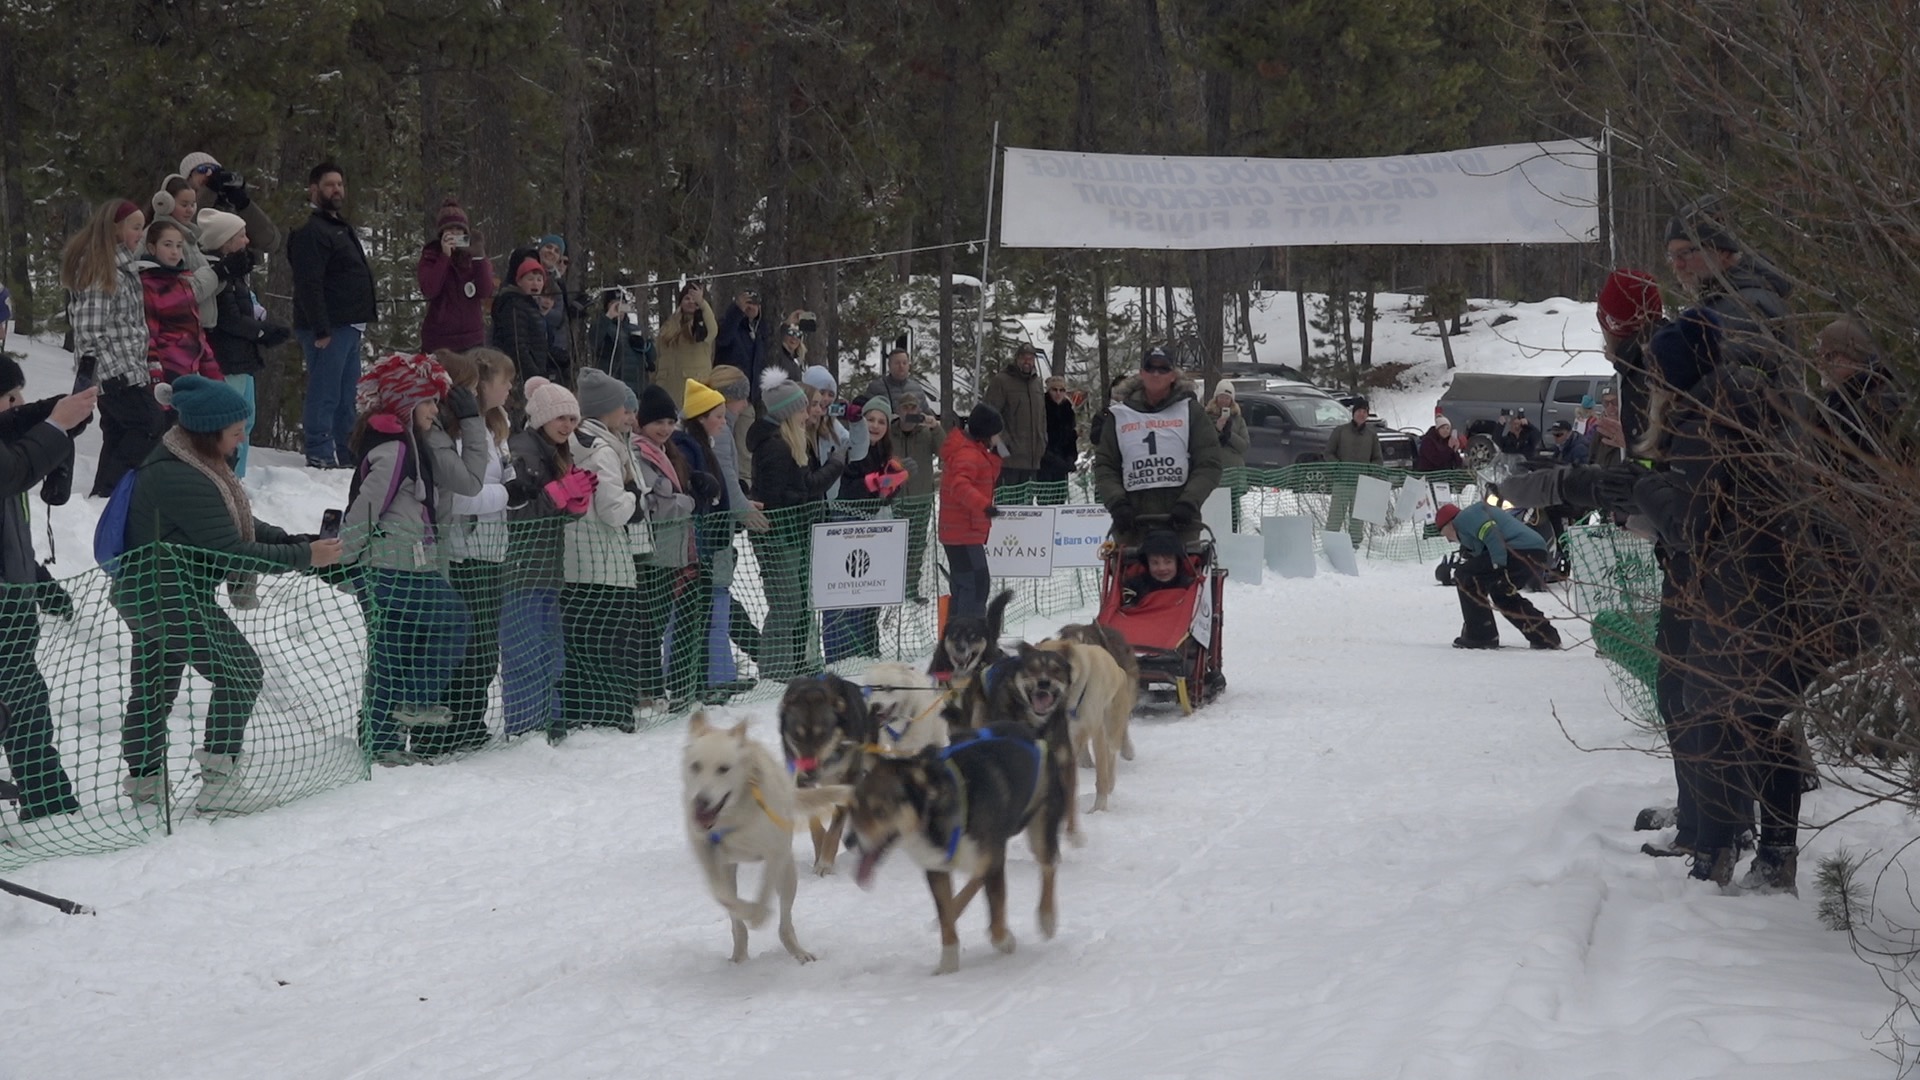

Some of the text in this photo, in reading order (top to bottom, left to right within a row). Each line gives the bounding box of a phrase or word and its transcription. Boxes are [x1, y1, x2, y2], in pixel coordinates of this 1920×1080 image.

[1142, 431, 1157, 455] 1
[1132, 456, 1175, 471] IDAHO
[1128, 467, 1183, 481] SLED DOG
[1127, 475, 1183, 488] CHALLENGE
[1064, 536, 1102, 545] Barn Owl
[983, 547, 1046, 558] ANYANS
[838, 580, 886, 589] DEVELOPMENT
